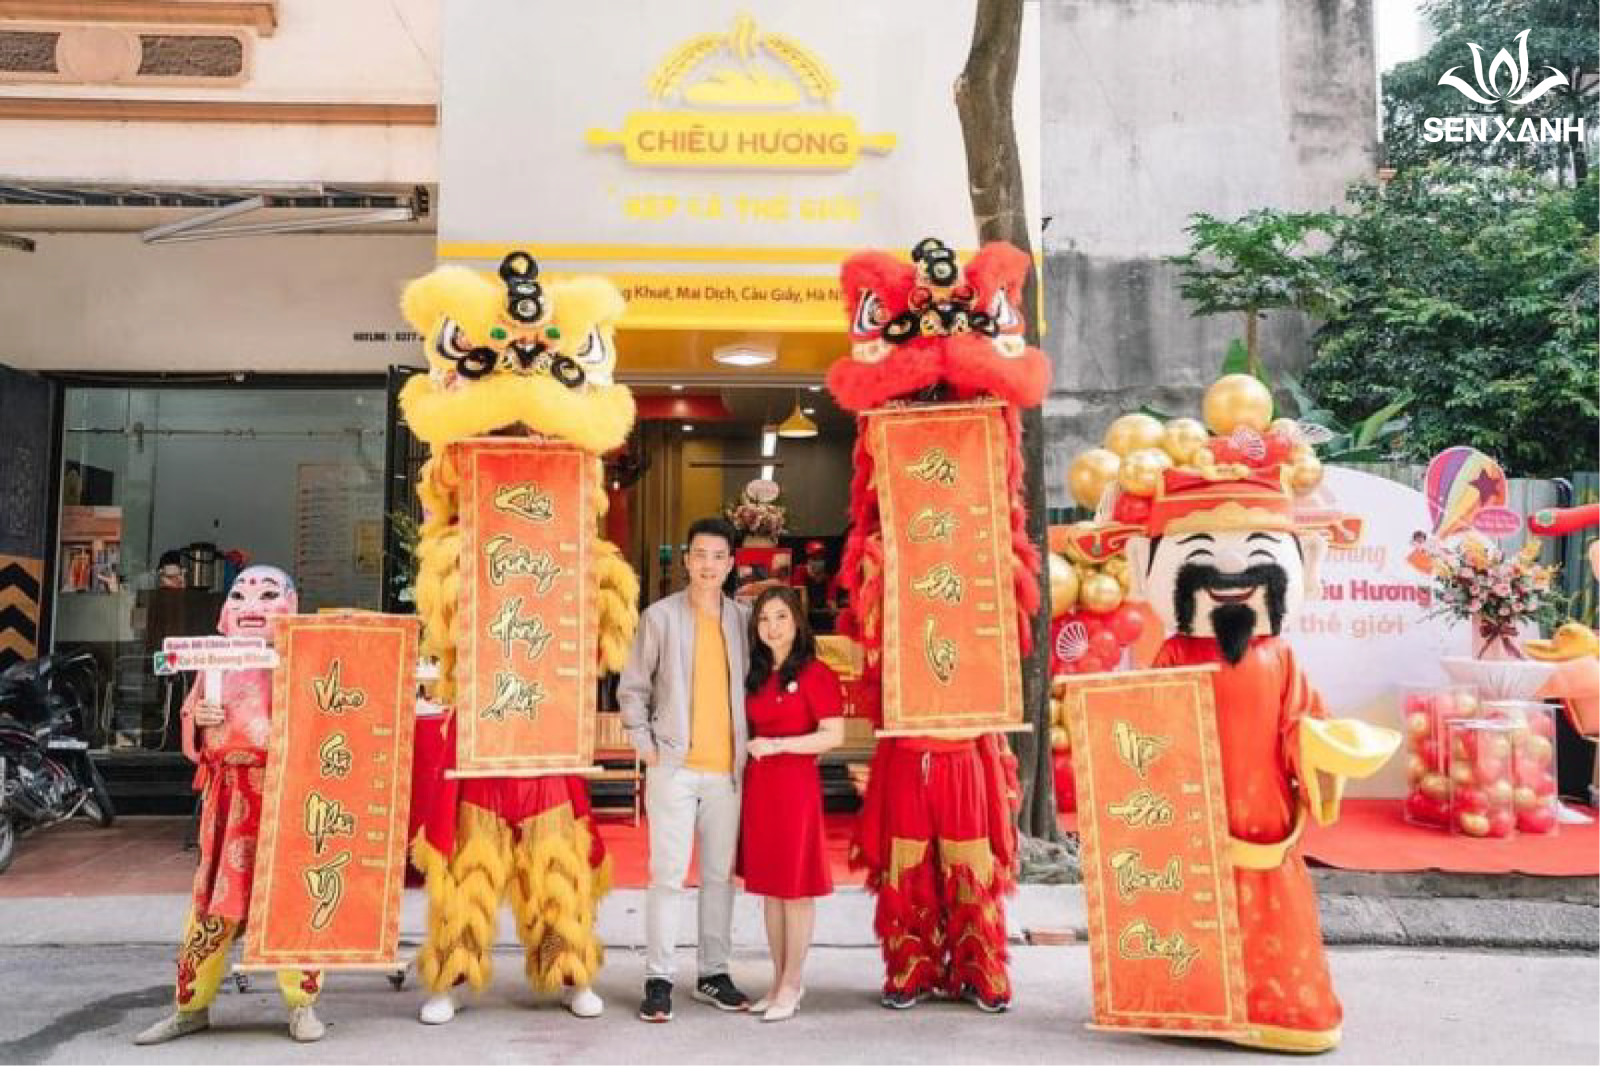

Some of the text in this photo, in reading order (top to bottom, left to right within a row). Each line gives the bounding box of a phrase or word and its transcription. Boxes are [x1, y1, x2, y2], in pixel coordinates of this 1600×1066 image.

[738, 127, 849, 155] HƯƠNG
[677, 286, 700, 299] Mai
[807, 286, 825, 301] Hà
[1352, 579, 1431, 607] Hương
